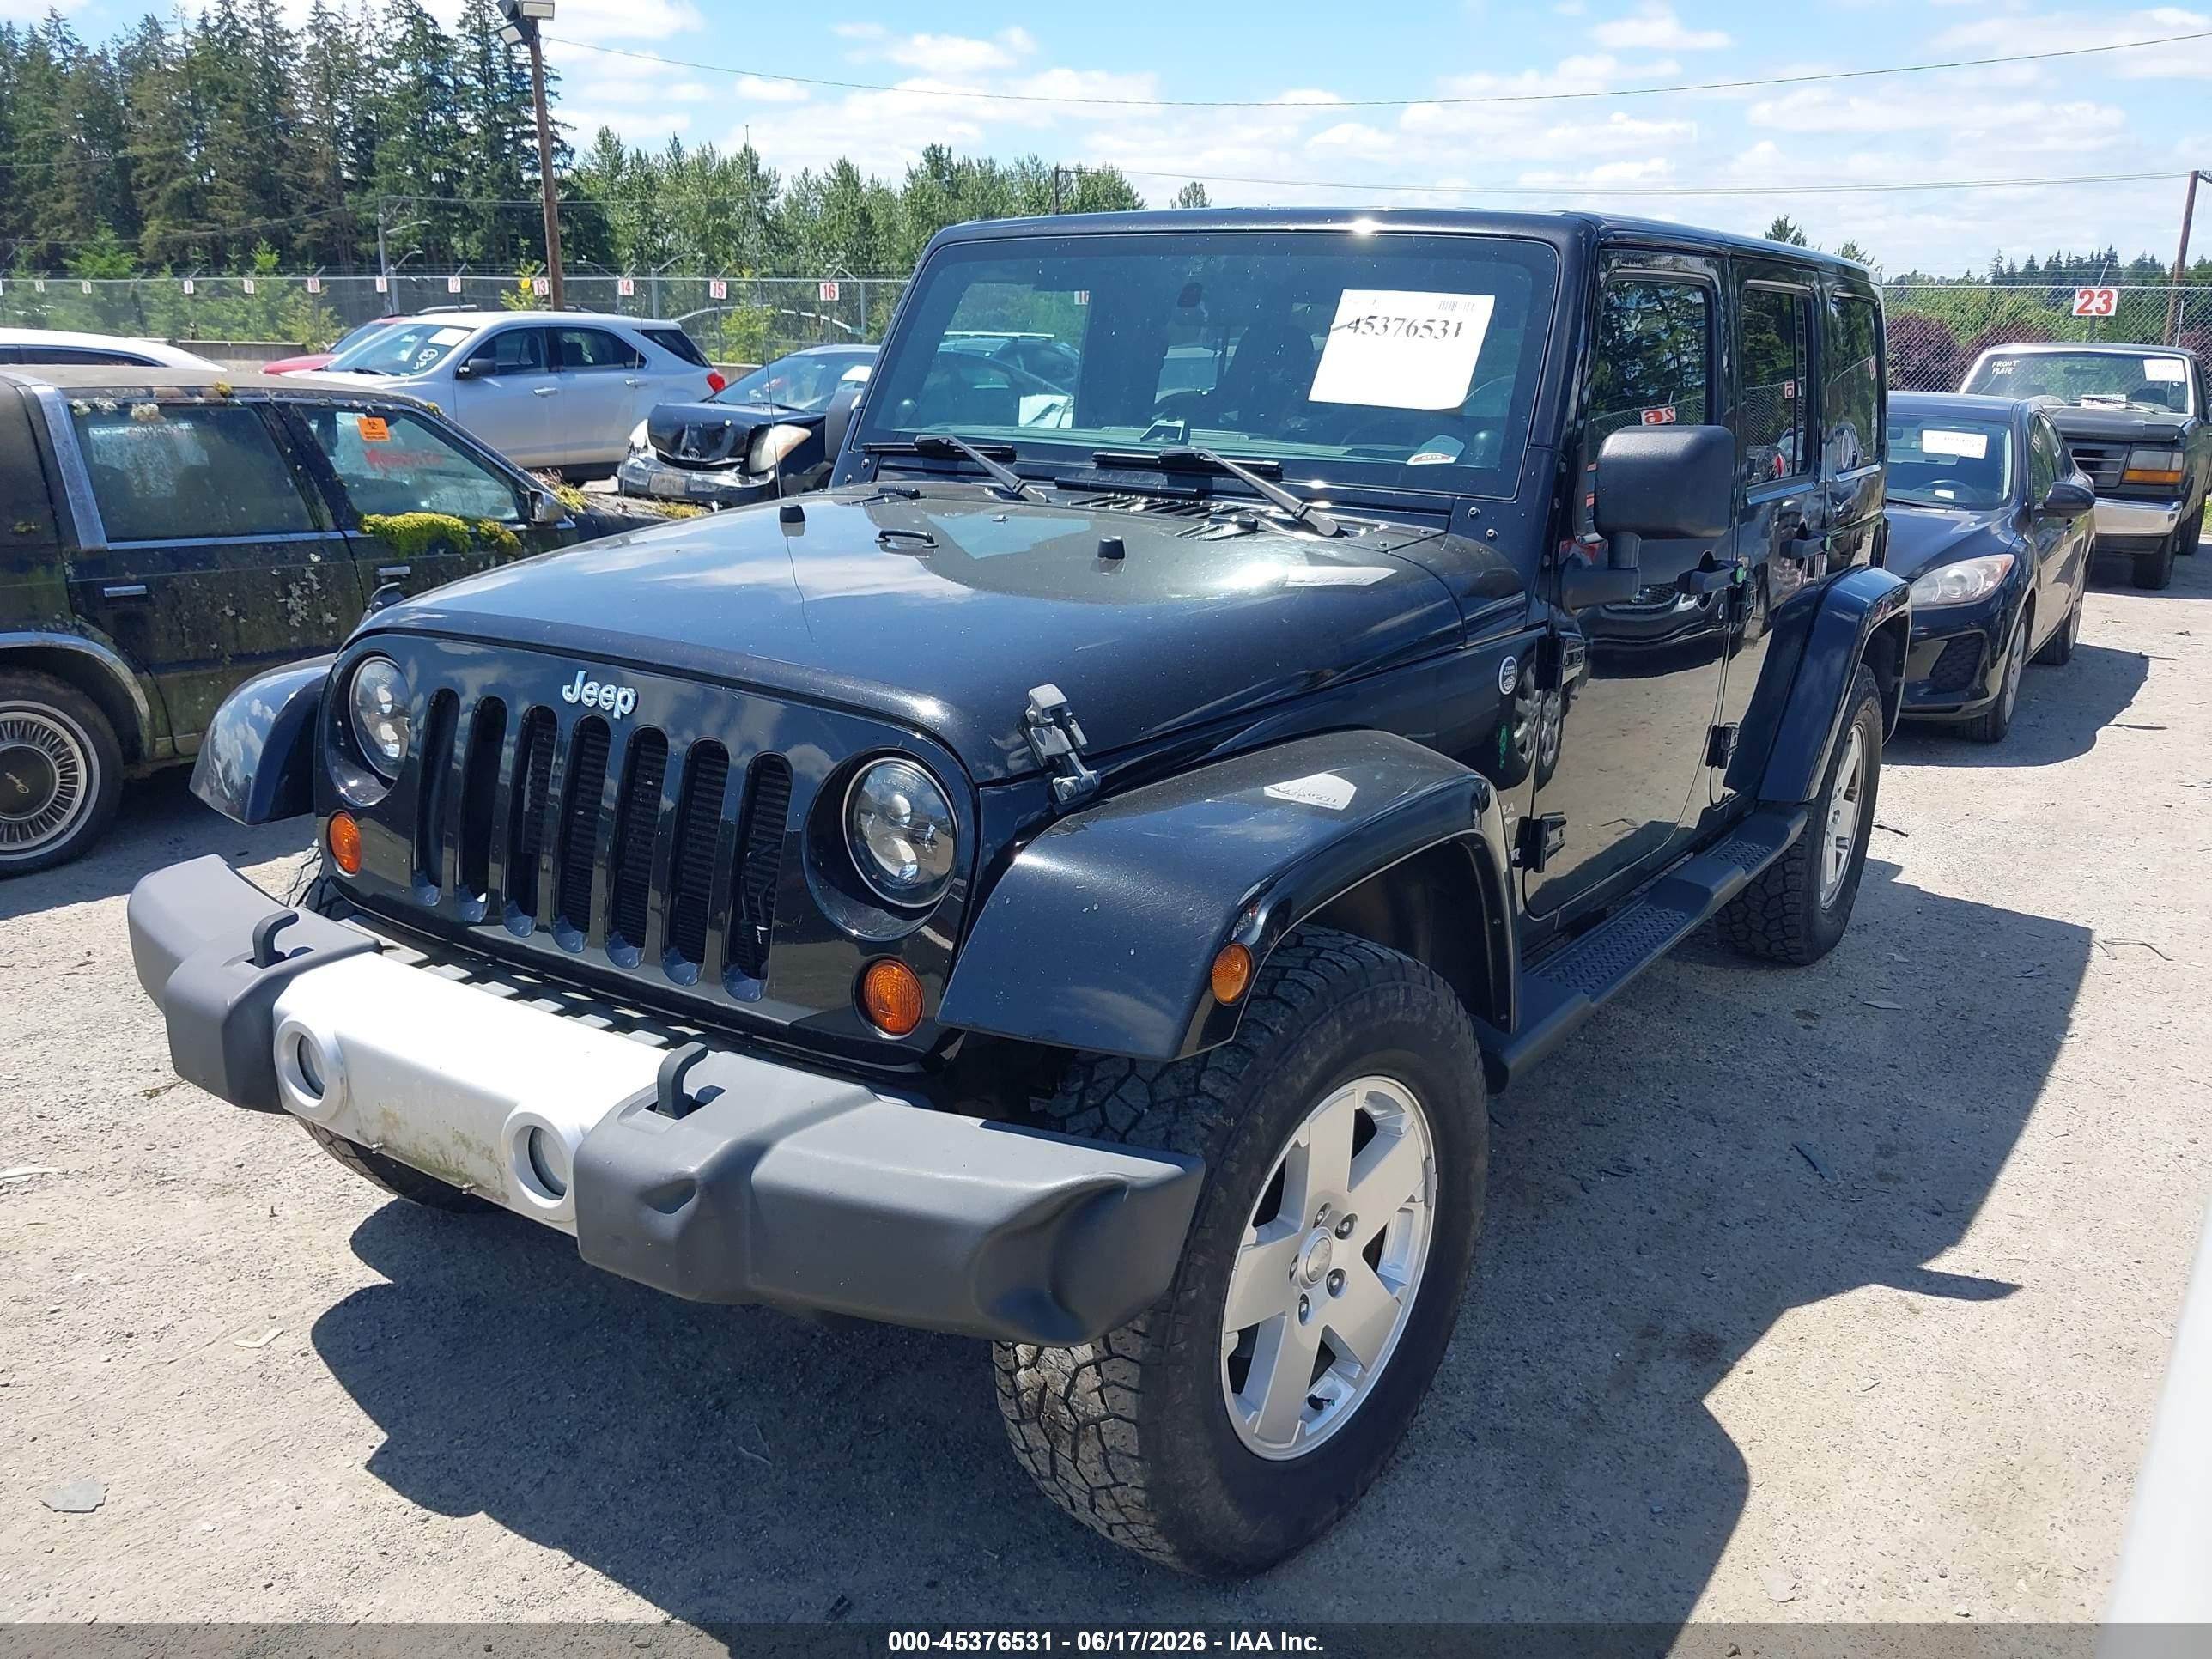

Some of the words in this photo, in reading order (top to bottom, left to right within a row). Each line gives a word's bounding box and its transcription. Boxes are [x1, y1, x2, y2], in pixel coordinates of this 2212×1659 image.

[451, 277, 459, 291] 12
[536, 280, 546, 294] 13
[622, 281, 631, 295] 14
[714, 283, 724, 297] 15
[823, 283, 836, 300] 16
[2076, 289, 2113, 315] 23
[1347, 315, 1463, 340] 45376531
[1991, 360, 2020, 368] FRONT
[562, 670, 638, 720] Jeep
